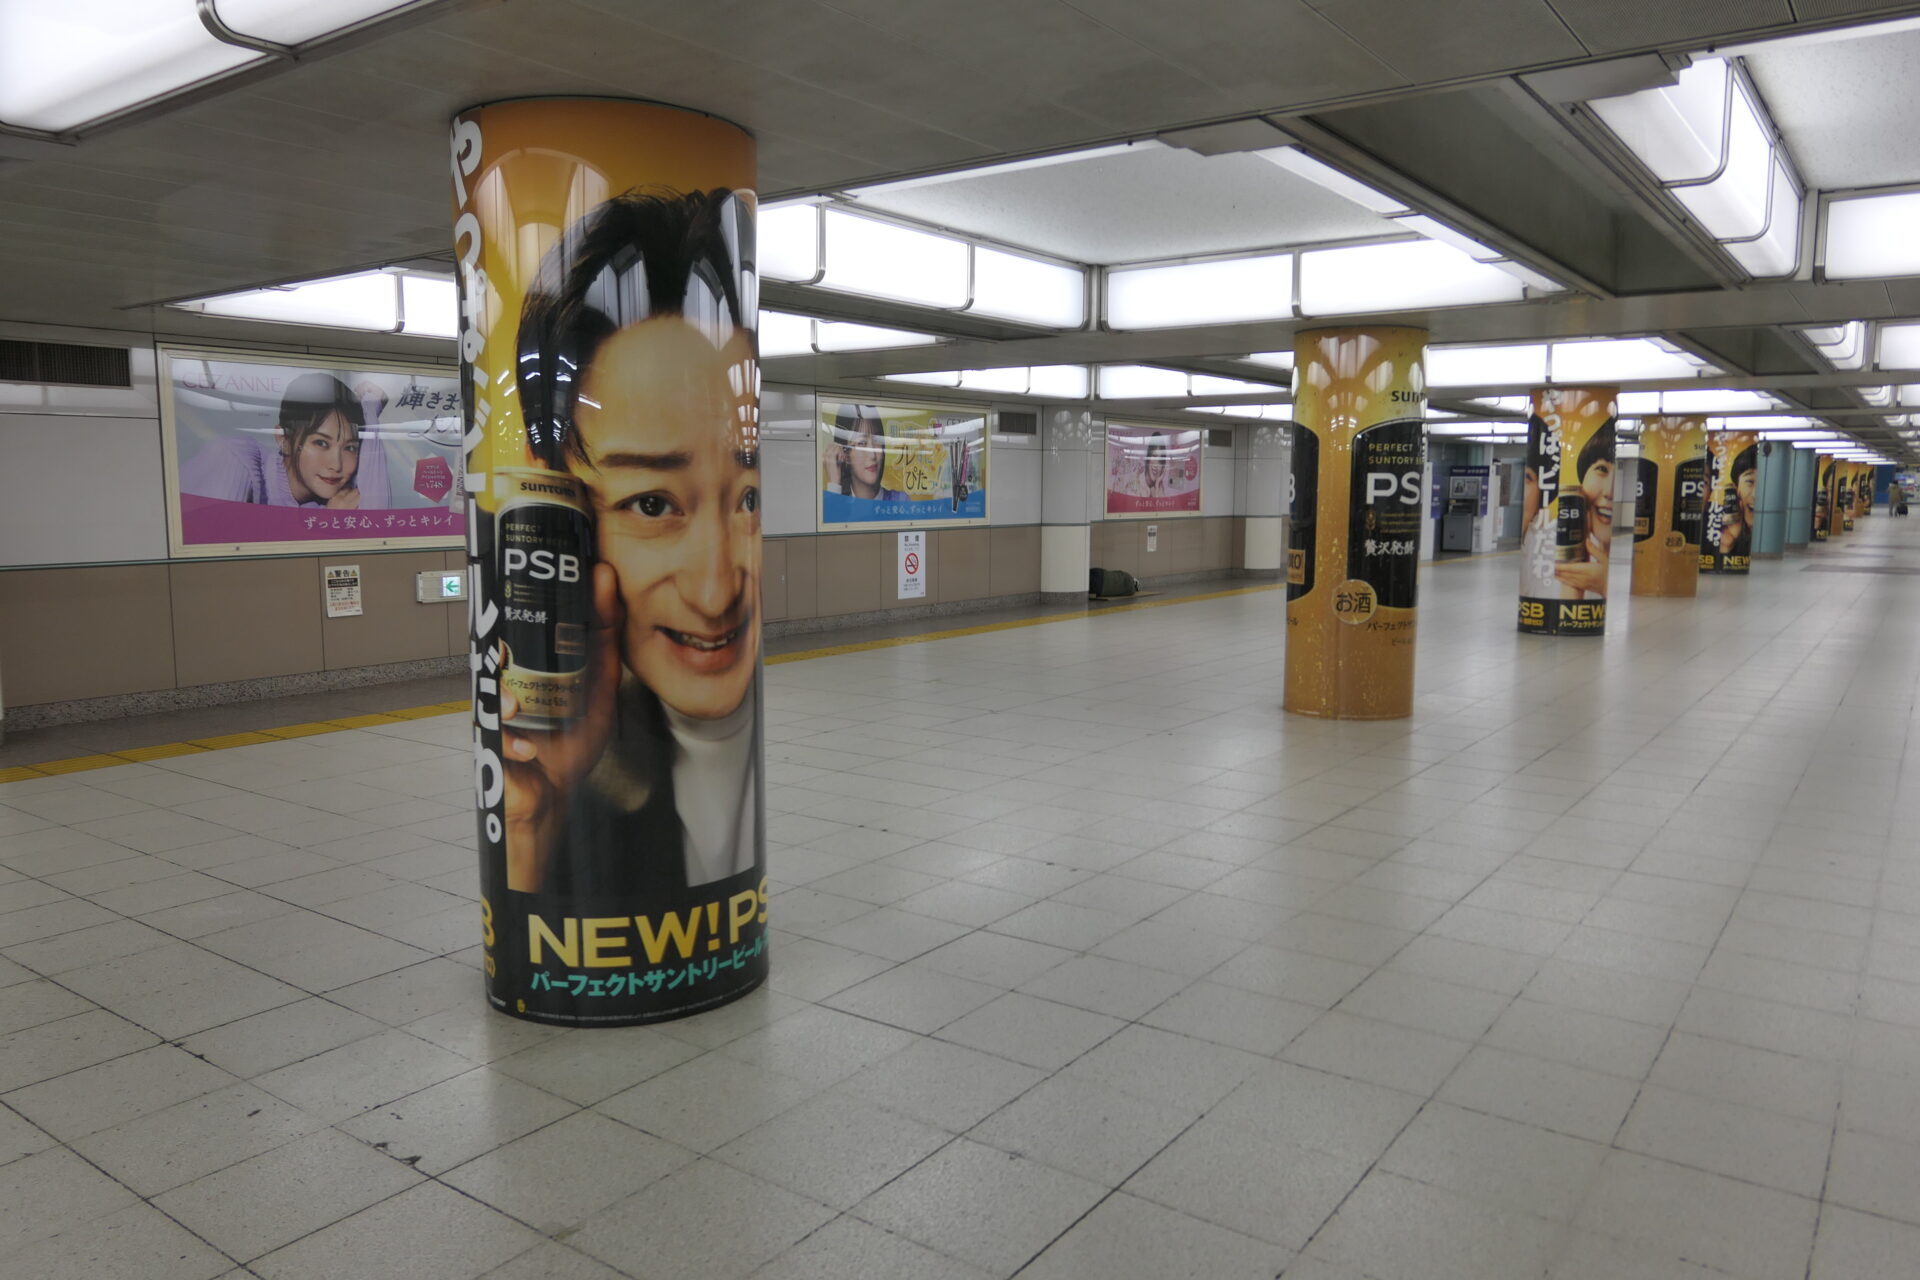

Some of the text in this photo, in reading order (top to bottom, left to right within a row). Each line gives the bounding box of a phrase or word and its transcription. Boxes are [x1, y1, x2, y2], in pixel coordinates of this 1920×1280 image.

[183, 373, 280, 393] CEZANNE
[1368, 443, 1413, 452] PERFECT
[1368, 456, 1413, 465] SUNTORY
[304, 514, 454, 530] ずっと安心、ずっとキレイ
[504, 548, 580, 583] PSB
[1336, 592, 1372, 613] お酒
[528, 902, 720, 968] NEW!
